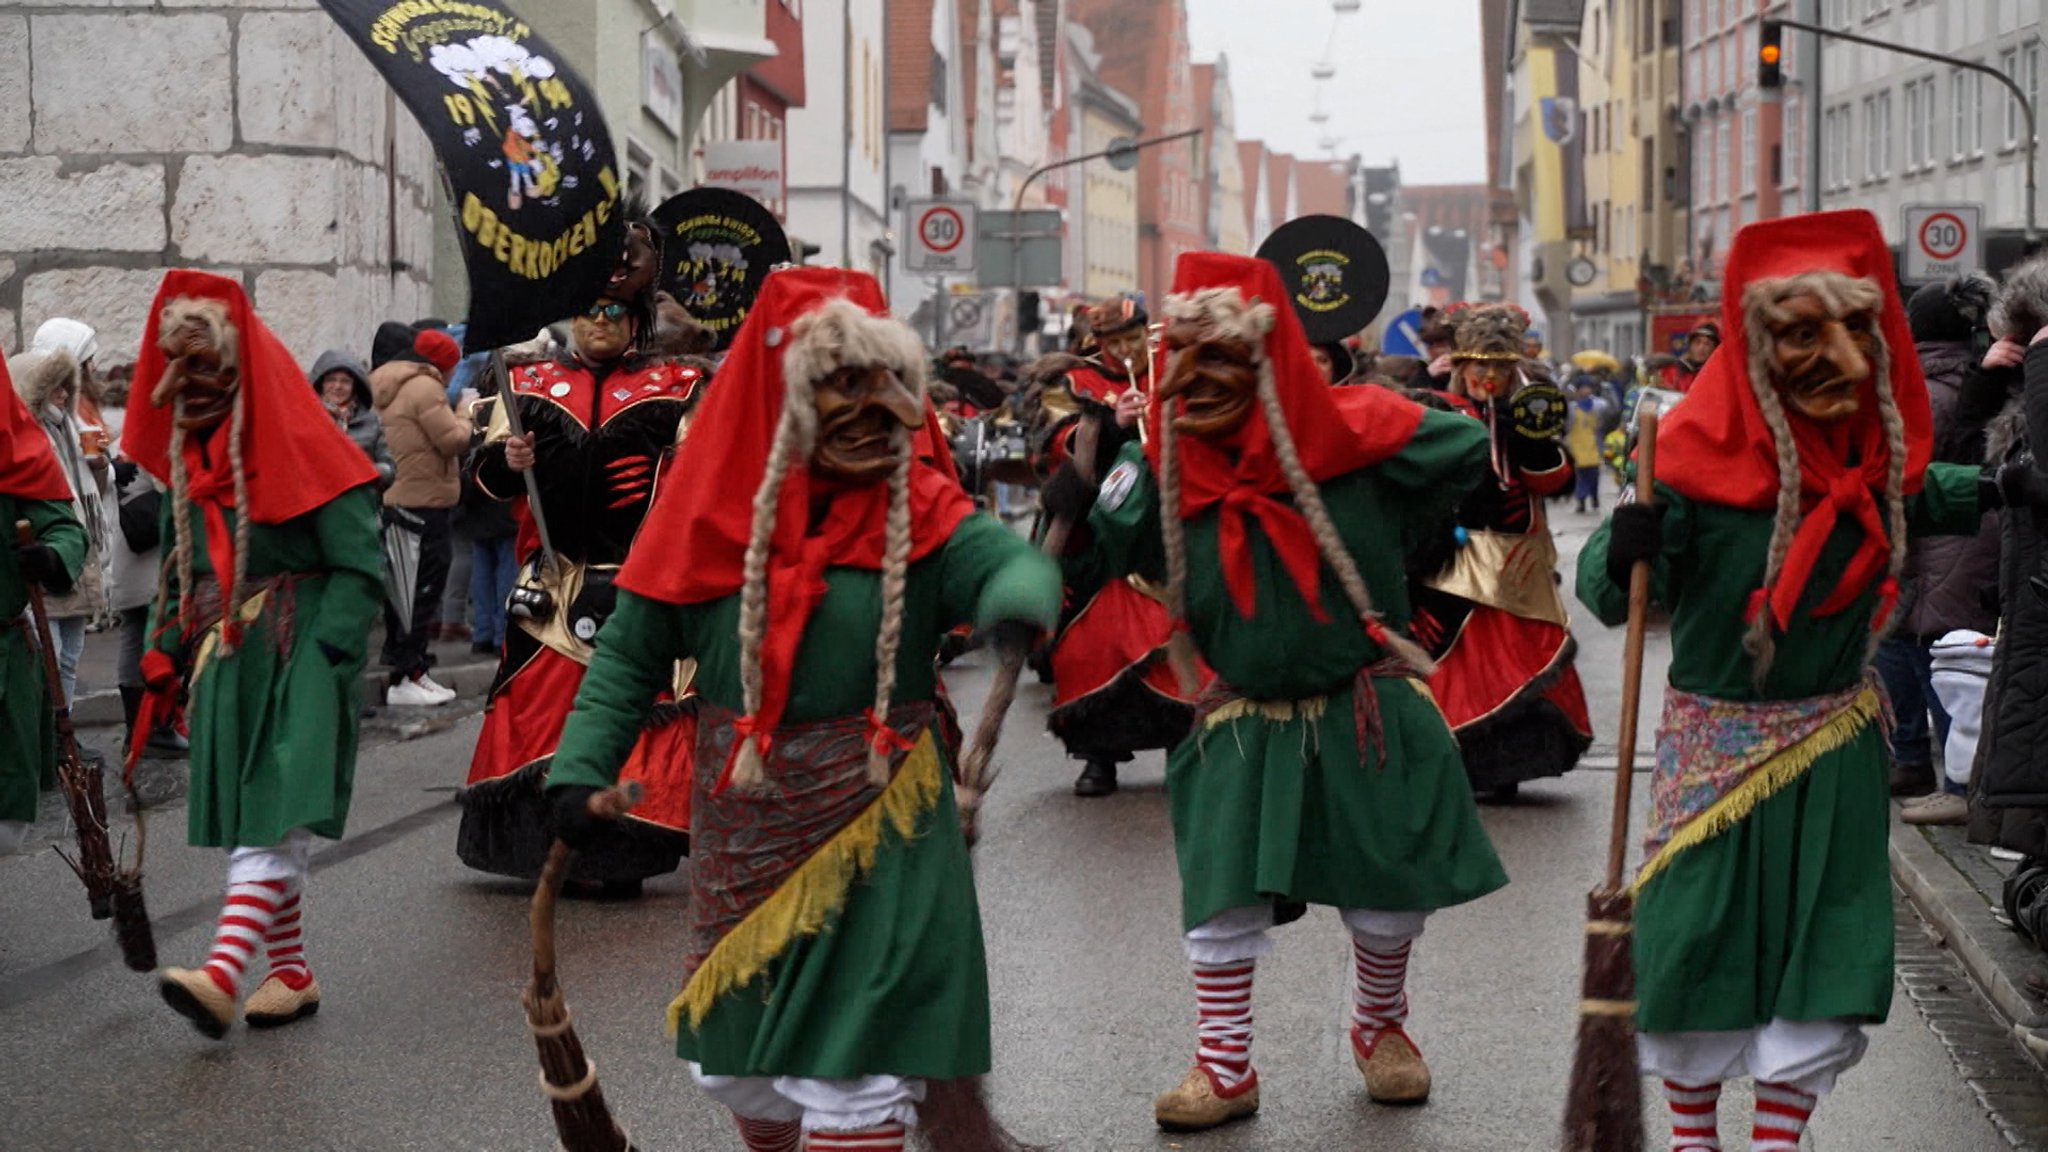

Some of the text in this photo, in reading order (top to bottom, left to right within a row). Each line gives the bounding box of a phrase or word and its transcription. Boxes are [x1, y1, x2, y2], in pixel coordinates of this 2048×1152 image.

[444, 93, 475, 126] 19
[707, 165, 779, 183] amplifon
[926, 218, 955, 241] 30
[1929, 225, 1957, 248] 30
